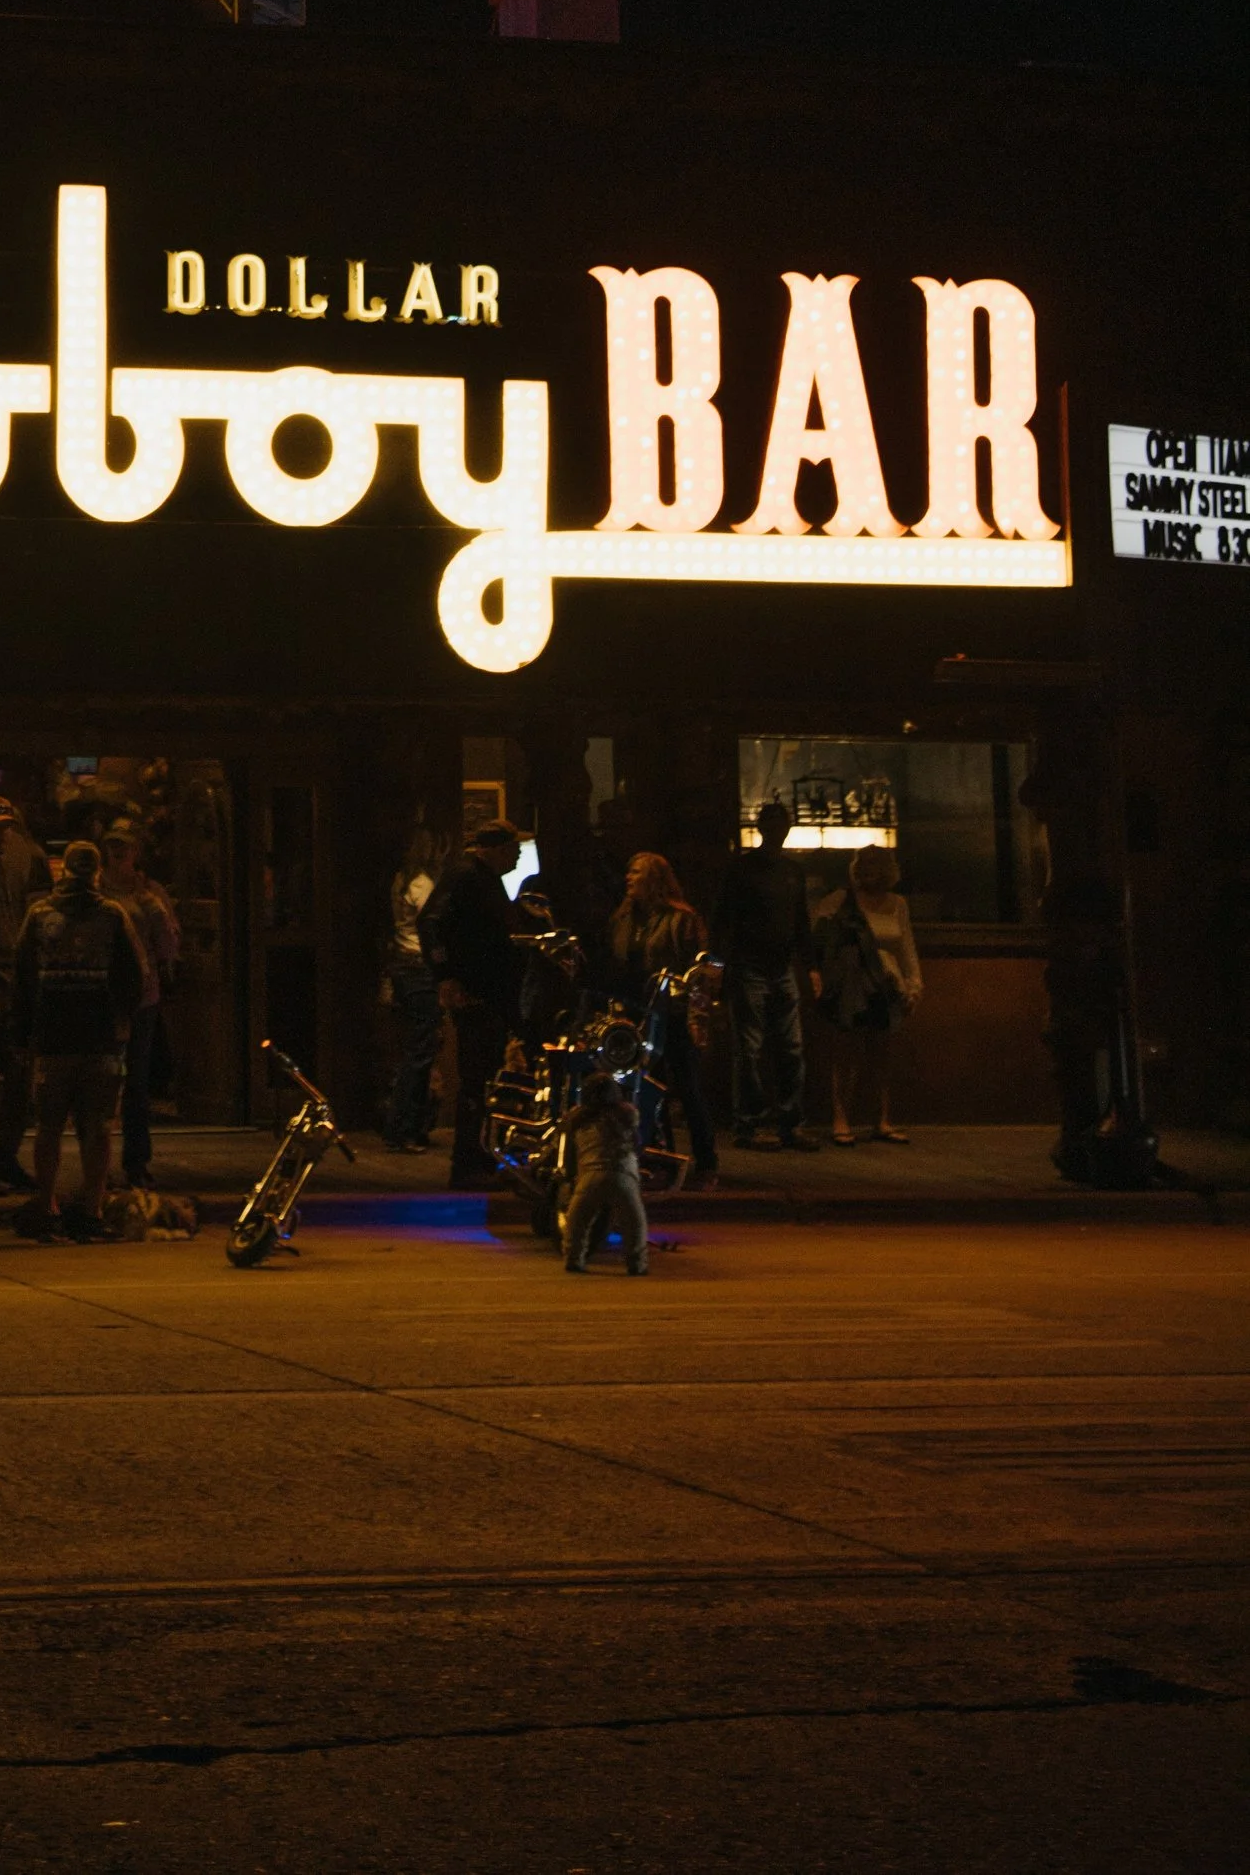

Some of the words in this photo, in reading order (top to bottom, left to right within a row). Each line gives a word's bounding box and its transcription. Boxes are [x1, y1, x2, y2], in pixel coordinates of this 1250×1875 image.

[163, 250, 503, 328] DOLLAR
[588, 265, 1061, 541] BAR
[1146, 429, 1197, 472] OPEN
[1125, 472, 1195, 515] SAMMY
[1143, 518, 1202, 560] MUSIC
